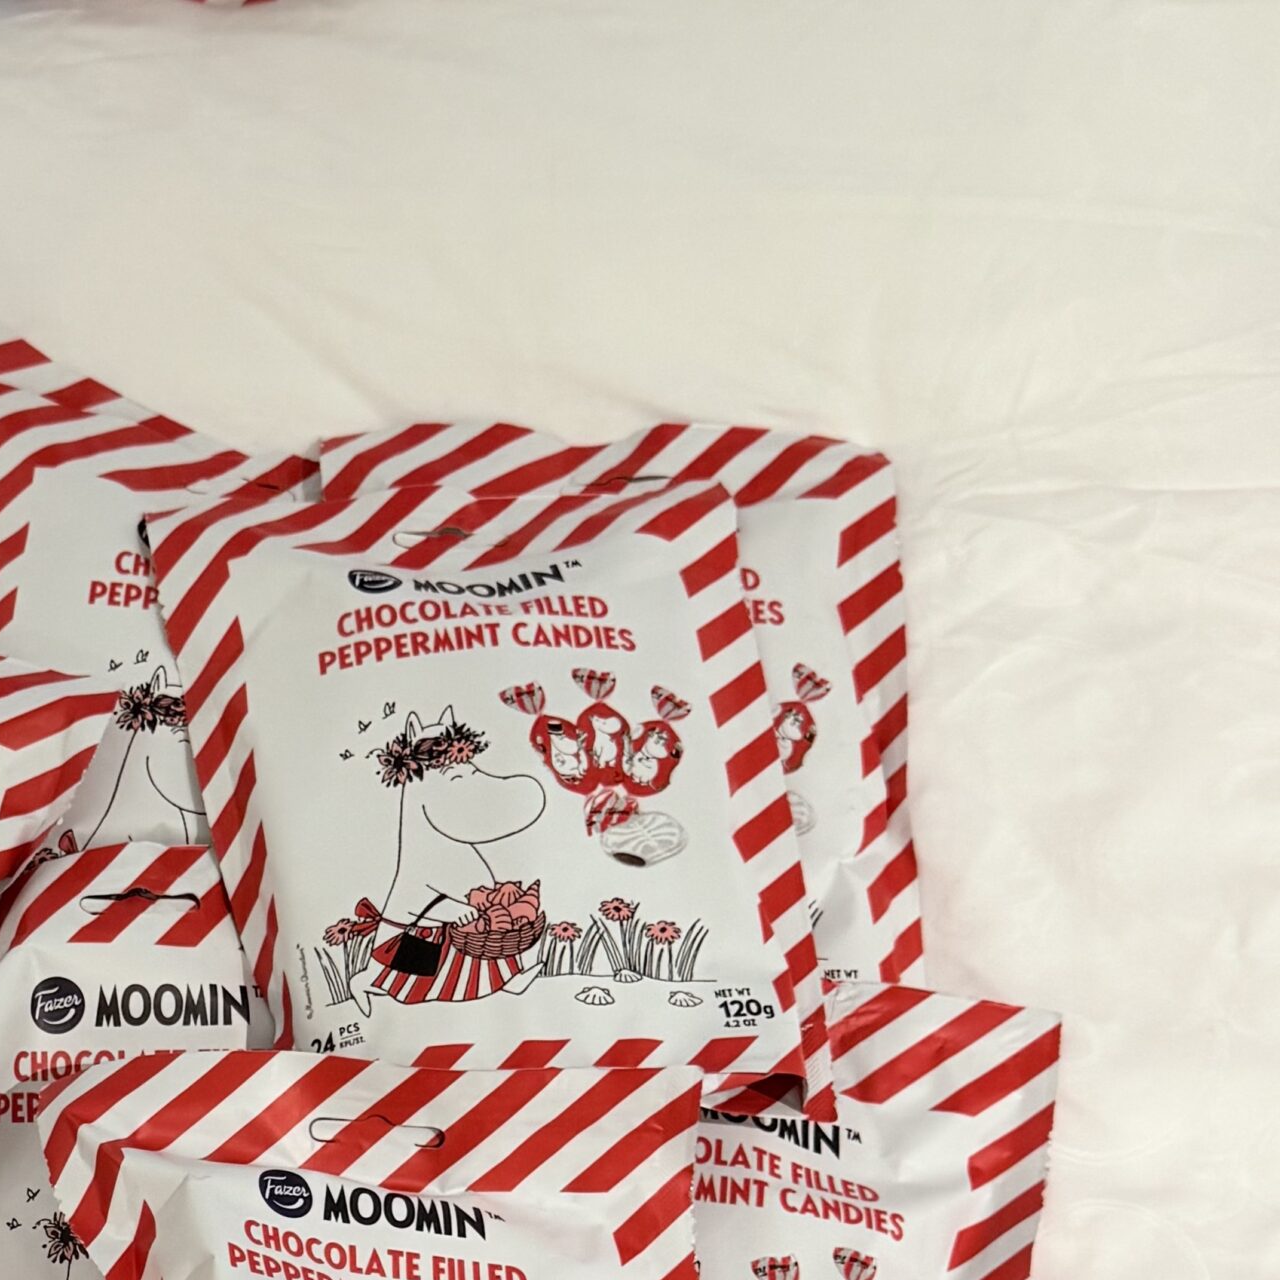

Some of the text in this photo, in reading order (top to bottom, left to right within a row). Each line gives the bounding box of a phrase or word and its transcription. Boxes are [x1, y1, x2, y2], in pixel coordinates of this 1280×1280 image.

[336, 595, 608, 638] CHOCOLATE FILLED
[318, 621, 637, 675] PEPPERMINT CANDIES
[36, 988, 84, 1021] Fazer
[715, 989, 732, 998] NET
[719, 999, 775, 1019] 120g
[339, 1022, 360, 1036] PCS
[264, 1178, 311, 1201] Fazer
[791, 1162, 879, 1202] FILLED
[779, 1188, 905, 1242] CANDIES
